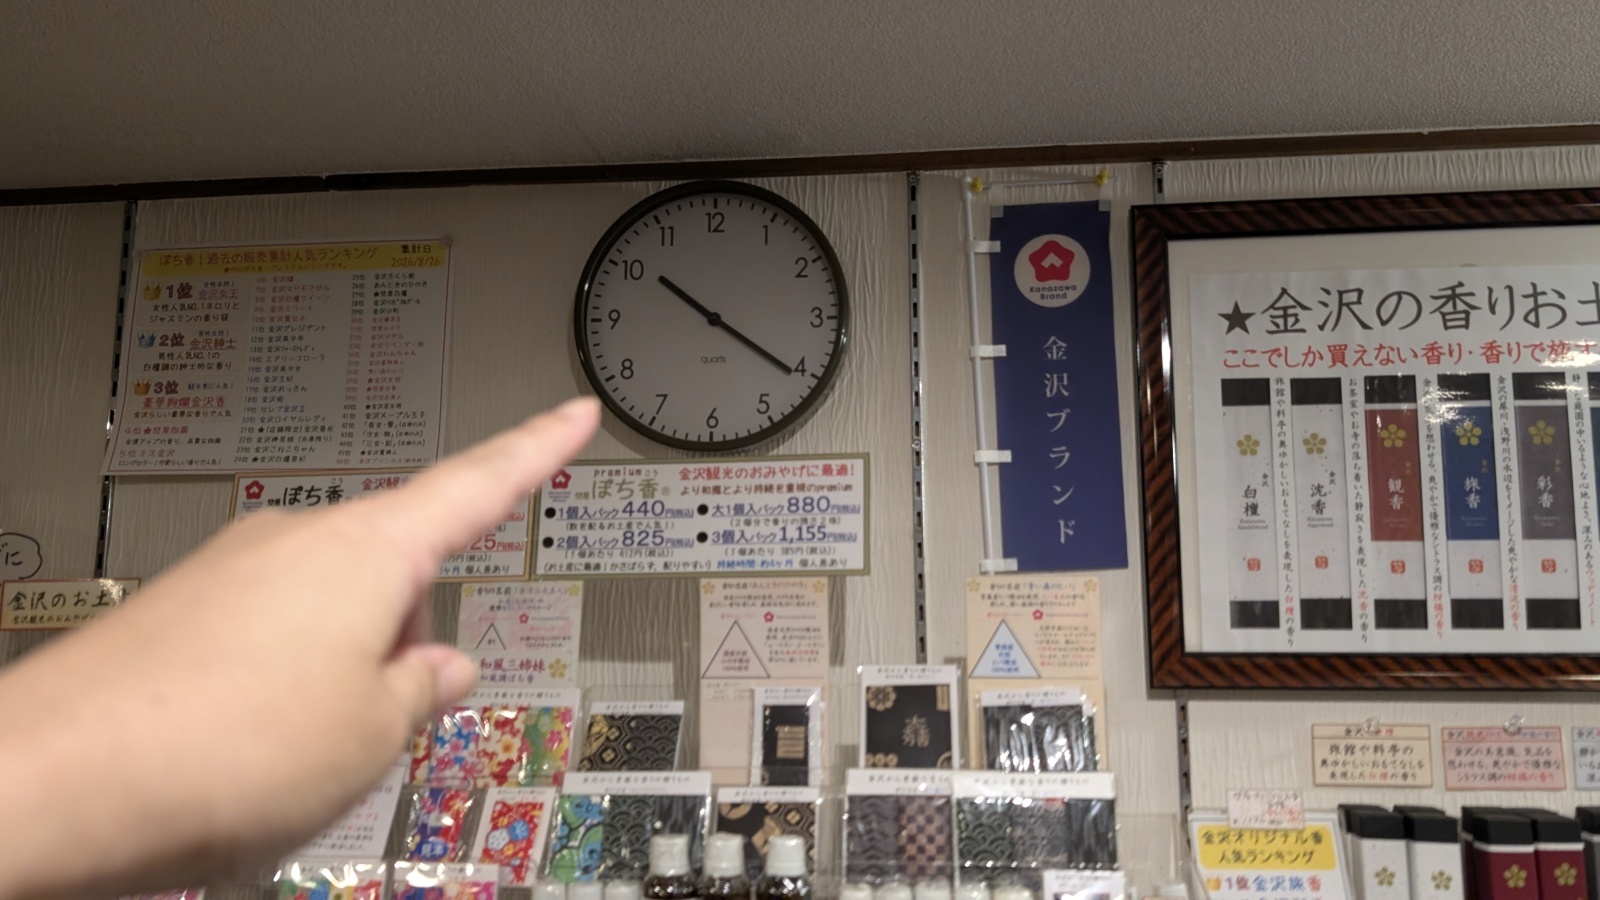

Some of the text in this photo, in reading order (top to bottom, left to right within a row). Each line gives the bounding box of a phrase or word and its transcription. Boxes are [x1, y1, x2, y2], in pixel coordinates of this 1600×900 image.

[705, 212, 725, 233] 12
[659, 226, 674, 247] 11
[762, 224, 769, 245] 1
[622, 259, 644, 281] 10
[794, 257, 809, 278] 2
[166, 282, 193, 299] 1位
[1029, 284, 1077, 293] Kanazawa
[1040, 292, 1067, 300] Brand
[150, 313, 228, 323] ジャスミンの香り袋
[809, 307, 823, 328] 3
[1261, 280, 1600, 335] 金沢の香りお土
[268, 324, 327, 333] 金沢プレジデント
[607, 308, 621, 330] 9
[158, 332, 236, 349] 2位 金沢紳士
[620, 358, 634, 380] 8
[792, 356, 807, 376] 4
[153, 380, 179, 394] 3位
[655, 394, 668, 415] 7
[755, 393, 769, 415] 5
[706, 407, 719, 429] 6
[1041, 335, 1075, 544] 金沢ブランド
[593, 467, 641, 478] premium
[678, 464, 855, 482] 金沢観光のおみやげに最適！
[282, 485, 344, 506] ぽち香
[362, 475, 411, 491] 金沢観
[592, 478, 659, 500] ぽち香
[1310, 483, 1326, 515] 沈香
[1241, 485, 1259, 517] 白檀
[464, 564, 510, 575] 個人差あり
[798, 559, 847, 569] 個人差あり
[13, 613, 95, 625] 金沢観光のおみやげ
[1202, 830, 1323, 845] 金沢オリジナル香
[1218, 849, 1314, 864] 人気ランキング
